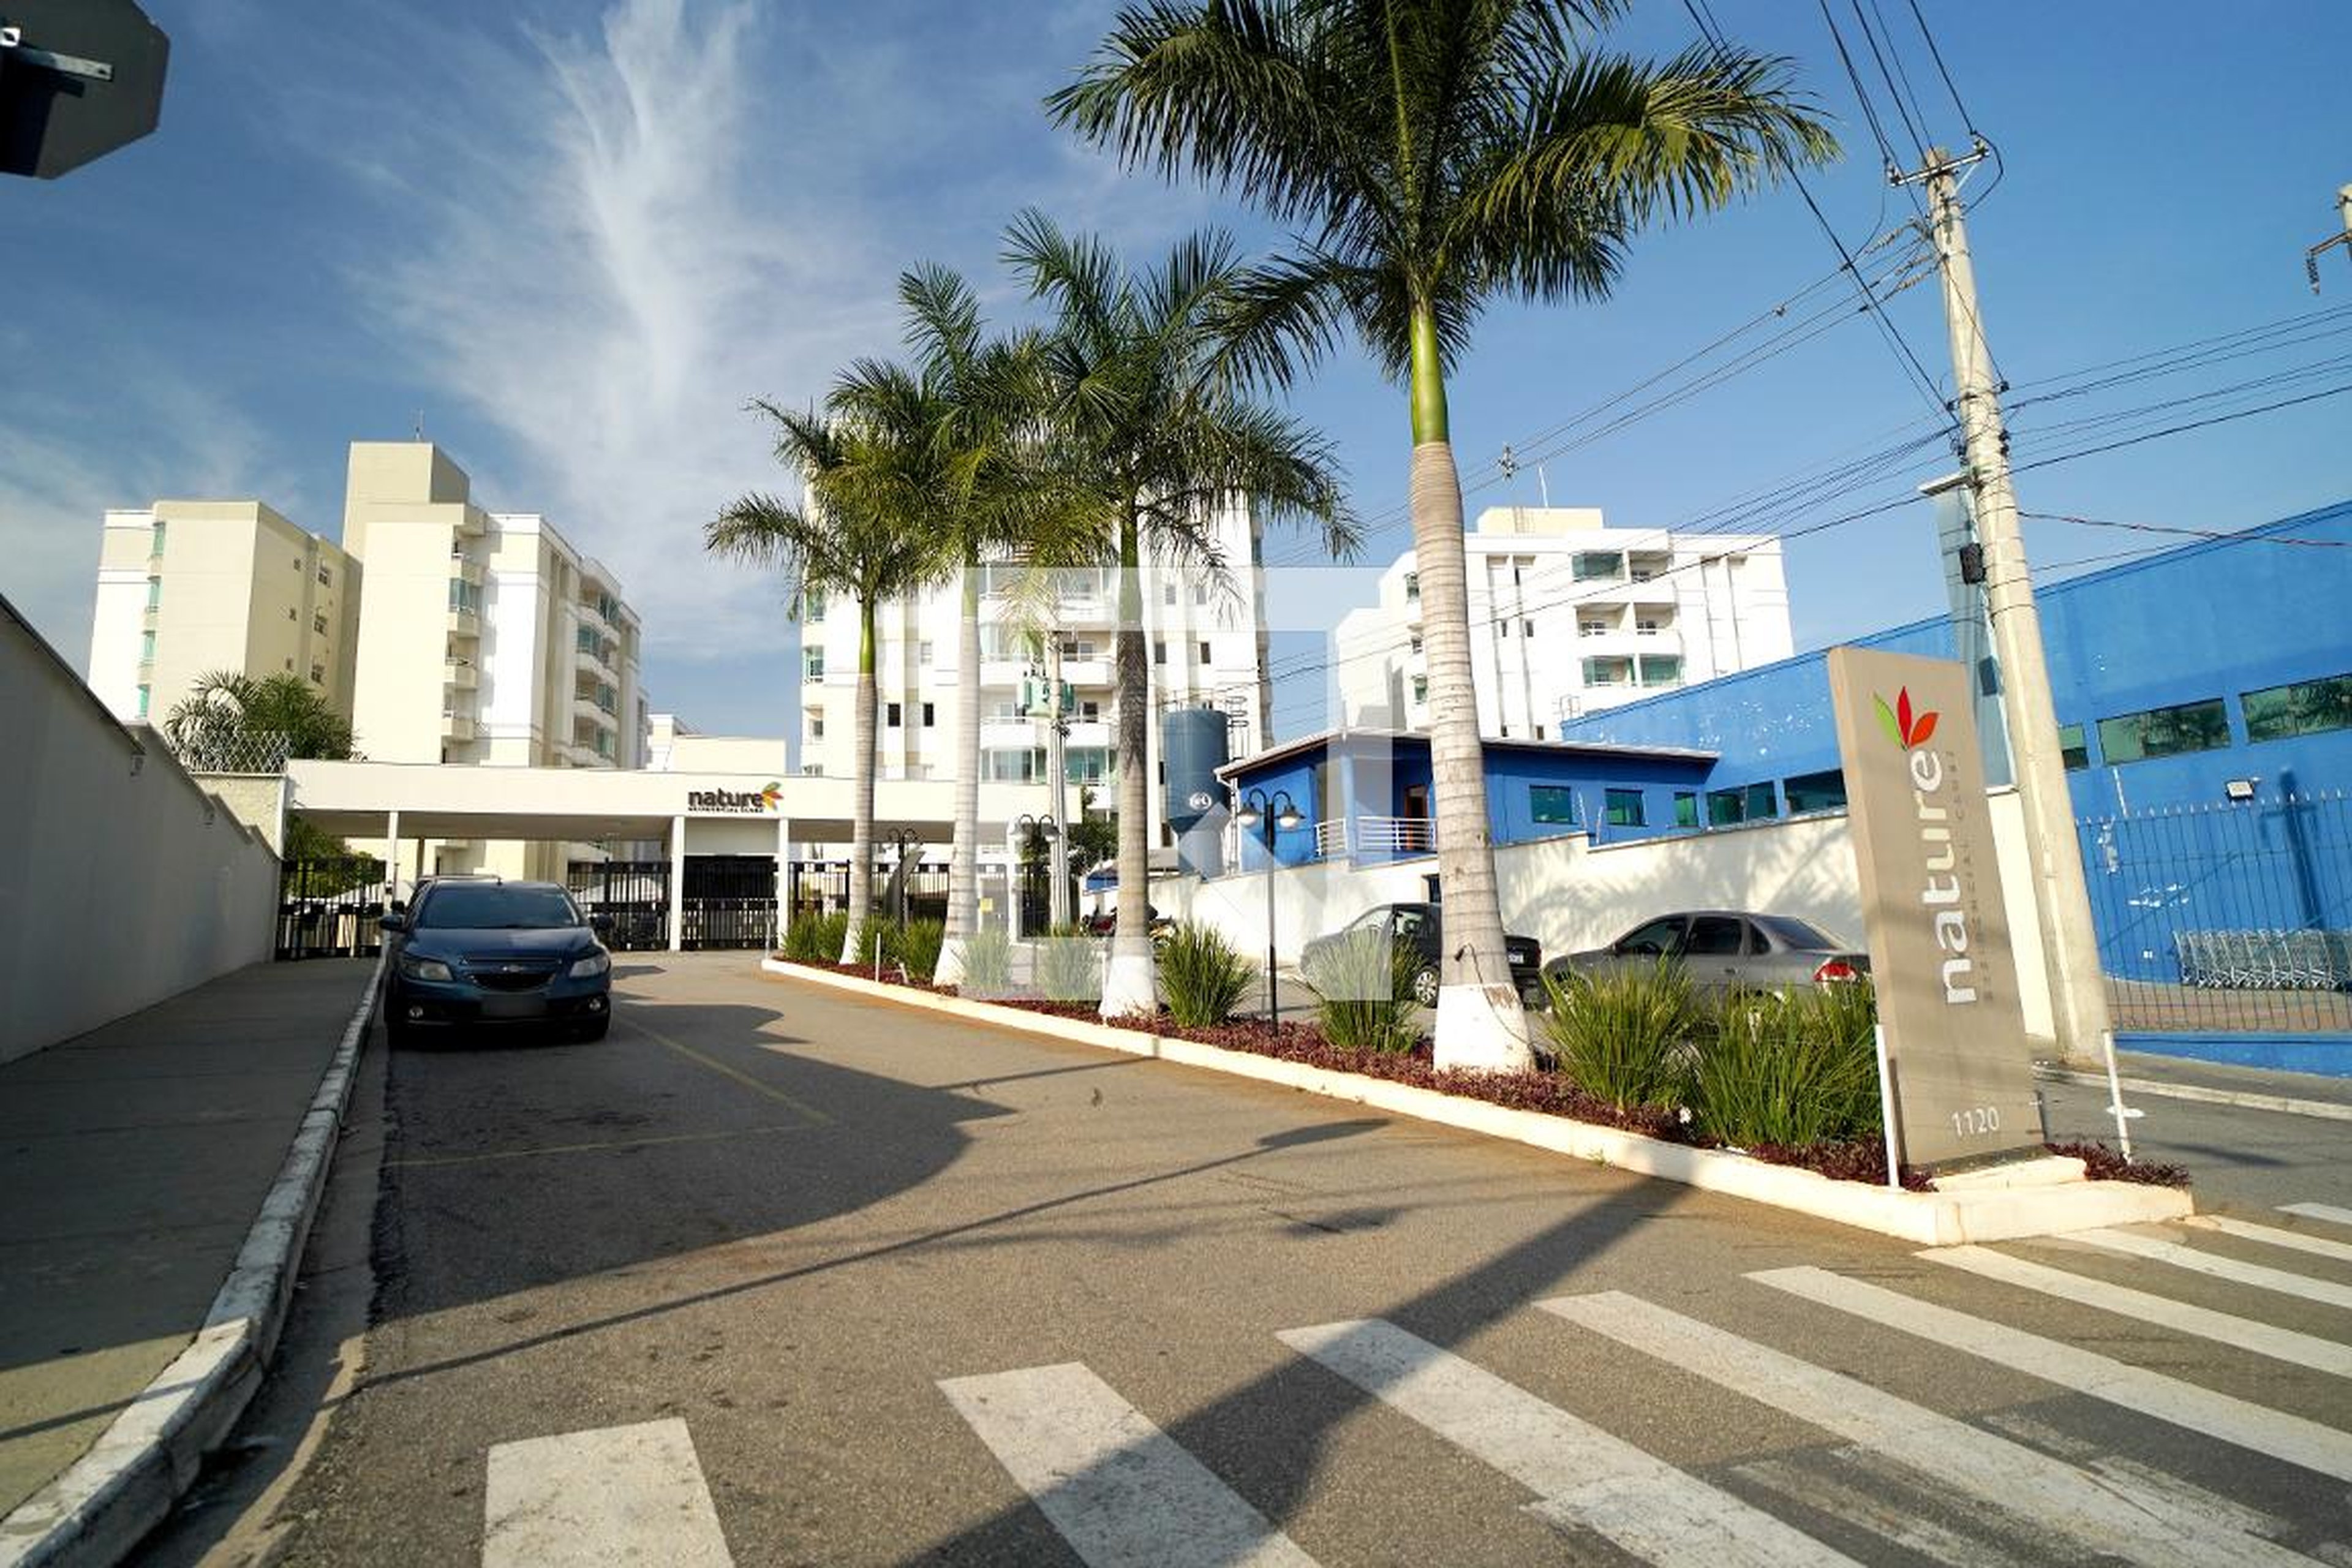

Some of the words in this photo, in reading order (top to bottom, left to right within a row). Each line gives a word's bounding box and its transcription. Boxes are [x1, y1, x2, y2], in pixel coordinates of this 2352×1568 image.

[688, 788, 763, 807] nature
[1910, 750, 1977, 1004] nature
[1952, 1106, 1999, 1136] 1120
